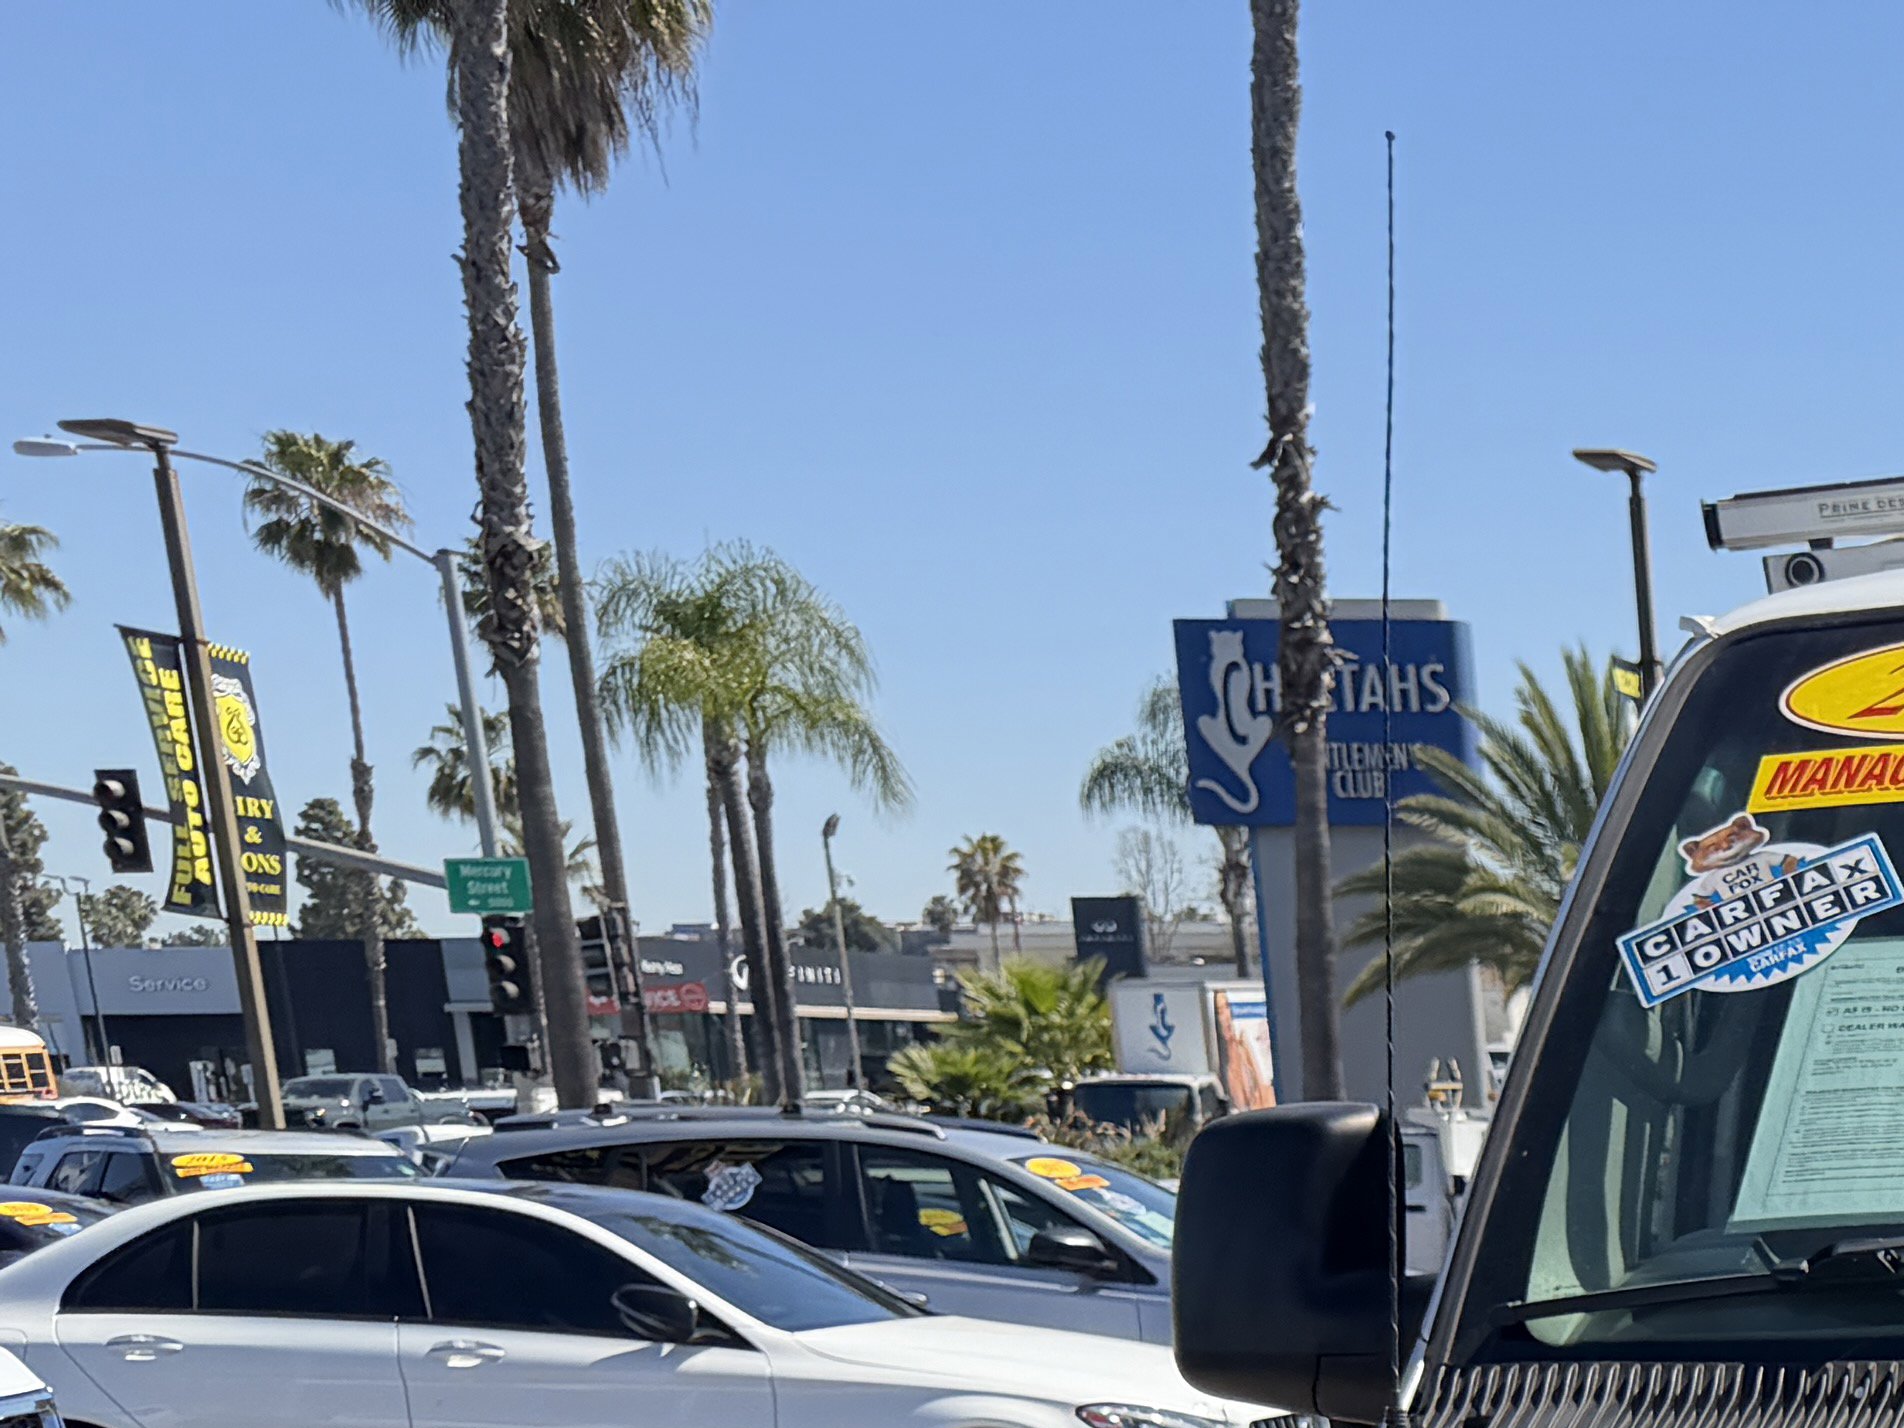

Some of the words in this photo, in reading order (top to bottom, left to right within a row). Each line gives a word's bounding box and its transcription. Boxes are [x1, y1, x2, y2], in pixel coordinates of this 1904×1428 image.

[127, 637, 184, 803] SERVICE
[158, 668, 192, 772] CARE
[235, 796, 273, 820] IRY
[1332, 770, 1385, 798] CLUB
[182, 779, 212, 887] AUTO
[244, 826, 262, 844] &
[172, 822, 193, 906] FULL
[240, 852, 282, 876] ONS
[1722, 862, 1759, 884] CAR
[1642, 857, 1870, 958] CARFAX
[1656, 963, 1681, 986] 1
[1692, 881, 1882, 968] OWNER
[128, 975, 207, 992] Service
